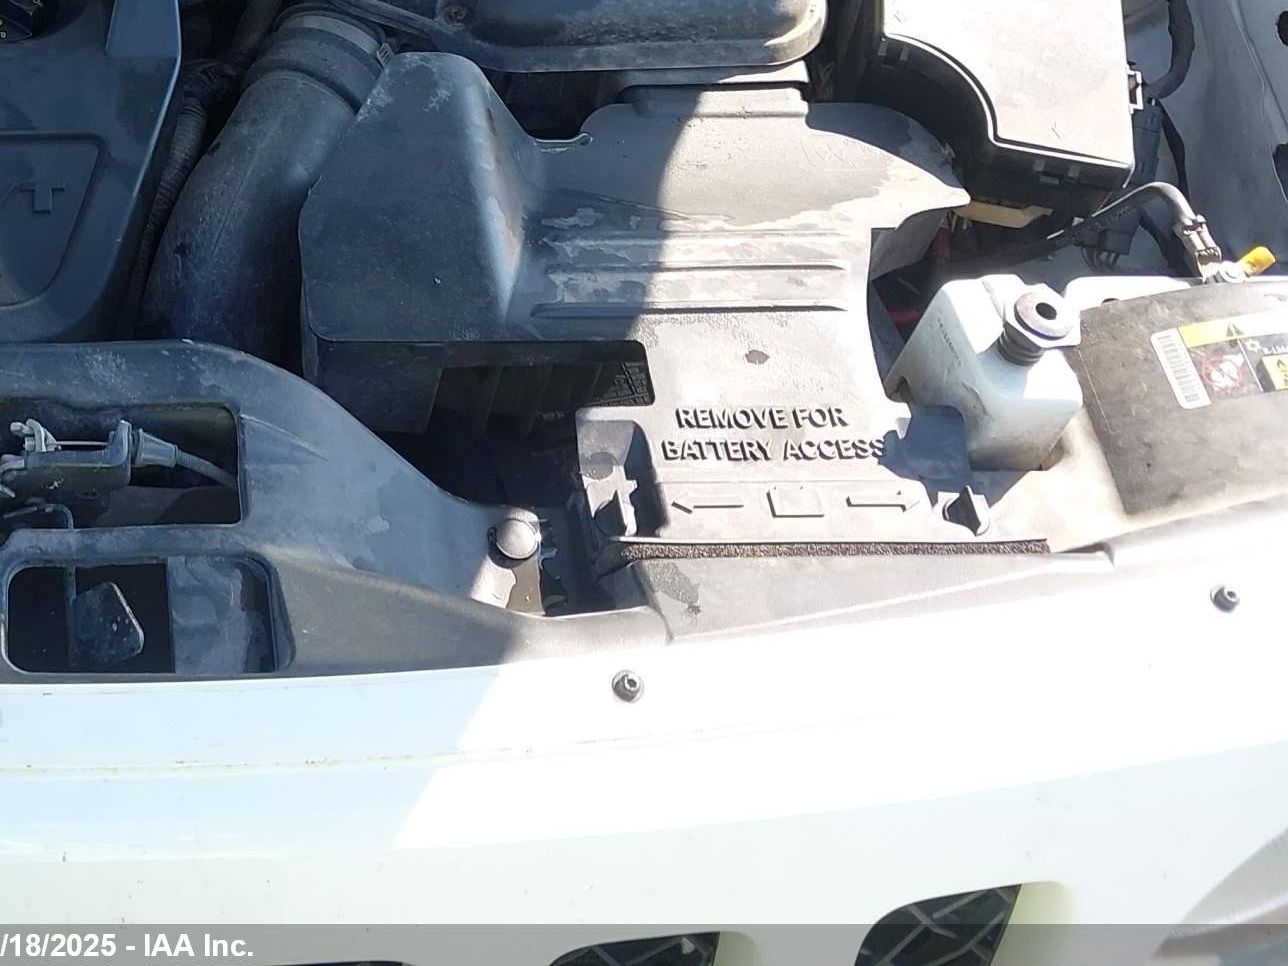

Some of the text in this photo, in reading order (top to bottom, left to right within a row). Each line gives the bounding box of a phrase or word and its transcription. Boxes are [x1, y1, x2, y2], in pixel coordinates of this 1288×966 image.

[675, 407, 850, 429] REMOVE FOR
[661, 439, 886, 462] BATTERY ACCESS
